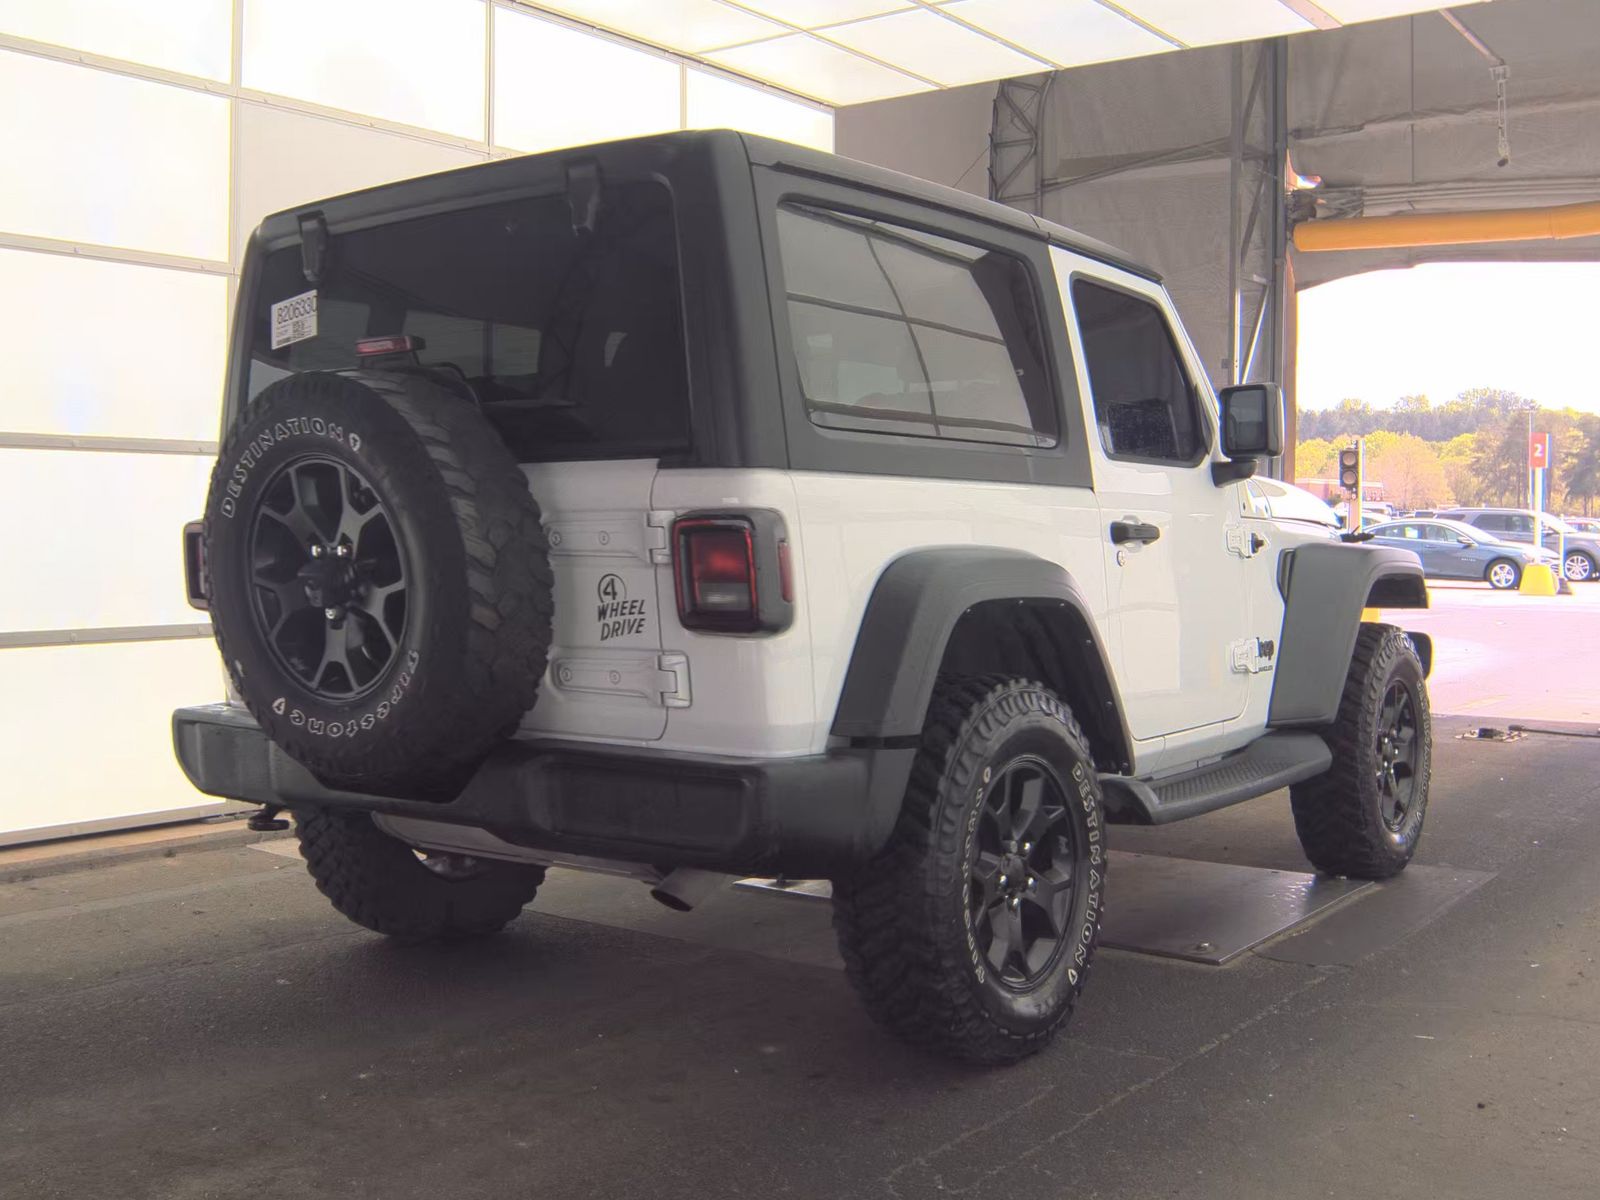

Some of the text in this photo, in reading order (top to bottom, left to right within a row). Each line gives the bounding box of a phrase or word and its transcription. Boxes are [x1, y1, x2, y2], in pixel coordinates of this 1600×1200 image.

[1534, 443, 1544, 457] 2
[221, 416, 344, 519] DESTINATION
[602, 578, 618, 600] 4
[597, 599, 646, 622] WHEEL
[600, 618, 646, 641] DRIVE
[1071, 761, 1102, 967] DESTINATION
